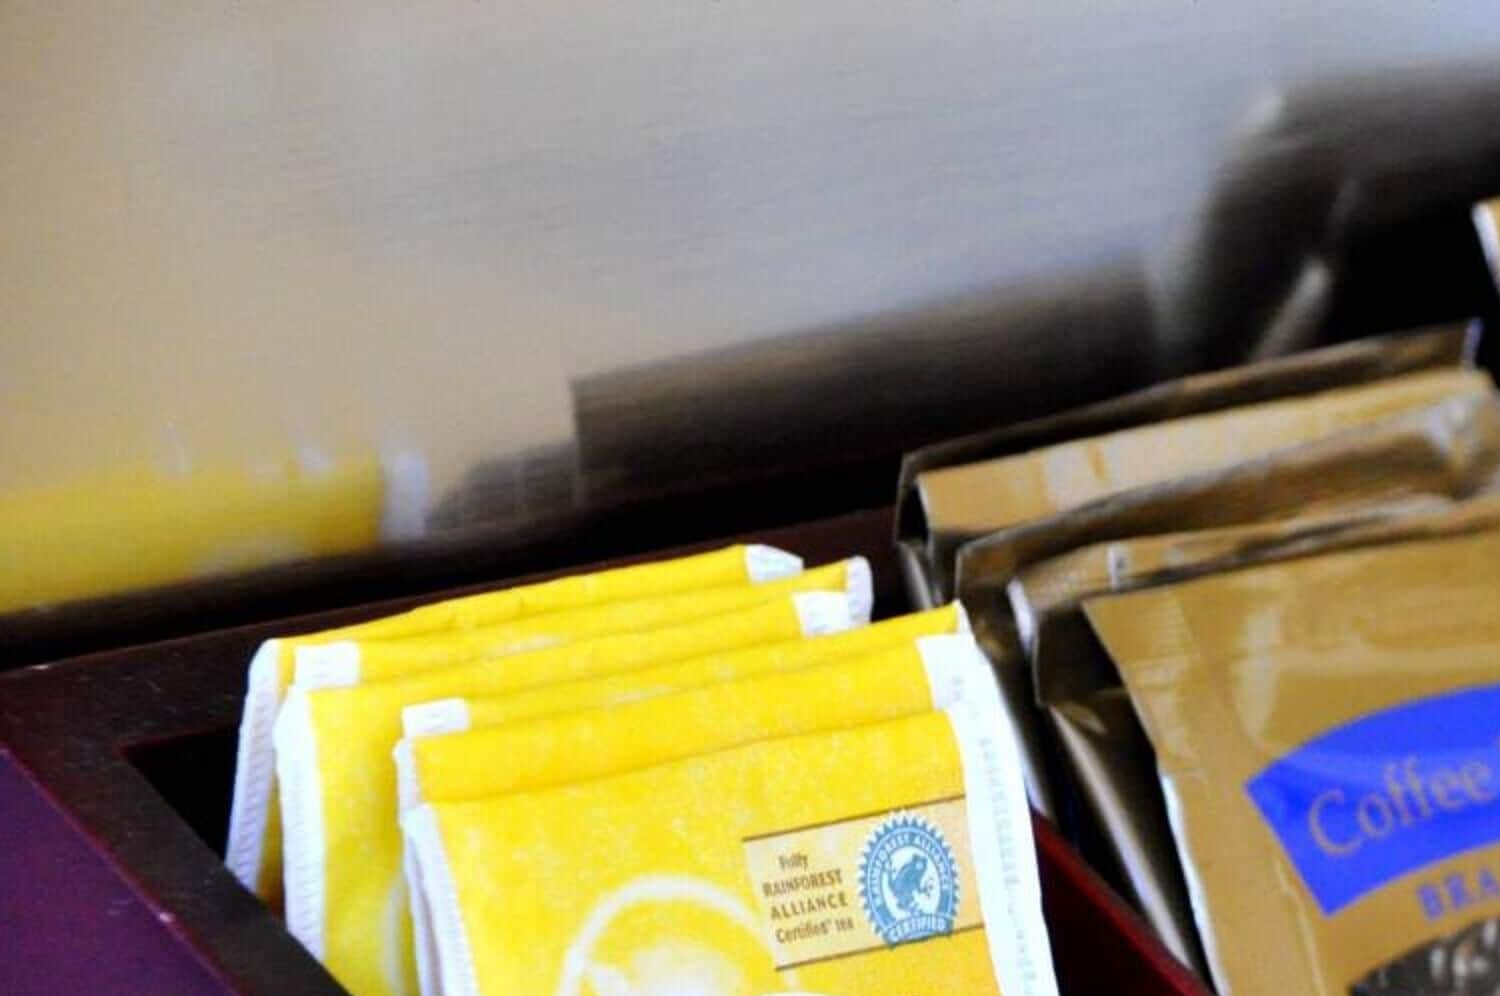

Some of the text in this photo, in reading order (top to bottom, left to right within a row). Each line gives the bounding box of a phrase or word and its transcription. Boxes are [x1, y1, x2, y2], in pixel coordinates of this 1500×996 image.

[1307, 754, 1496, 858] Coffee
[761, 869, 844, 898] RAINFOREST
[770, 891, 849, 921] ALLIANCE
